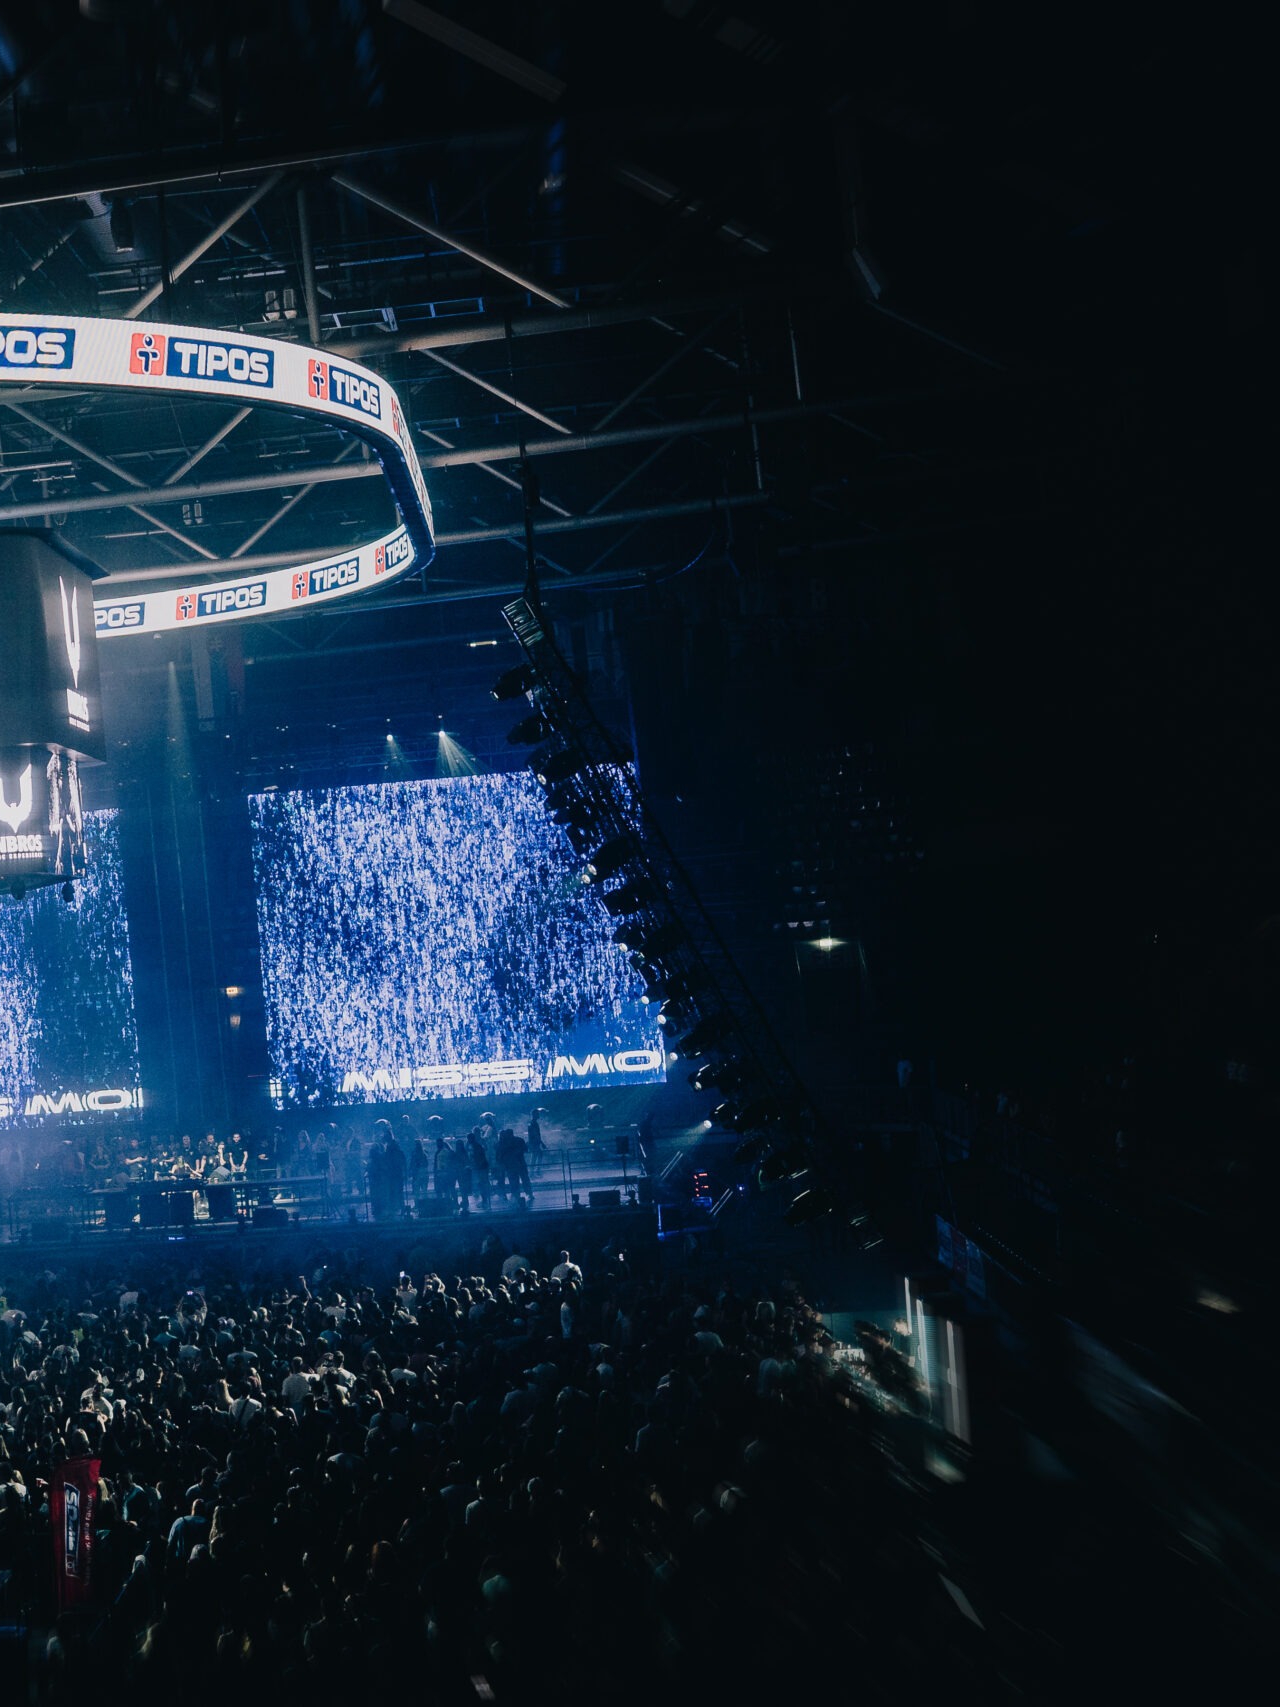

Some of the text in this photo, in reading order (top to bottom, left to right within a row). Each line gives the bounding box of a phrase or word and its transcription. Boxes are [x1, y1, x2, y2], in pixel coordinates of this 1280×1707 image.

[173, 341, 270, 384] TIPOS
[332, 373, 380, 417] TIPOS
[386, 535, 409, 567] TIPOS
[312, 562, 357, 592] TIPOS
[202, 586, 263, 614] TIPOS
[94, 605, 141, 629] POS
[340, 1058, 533, 1092] MISS
